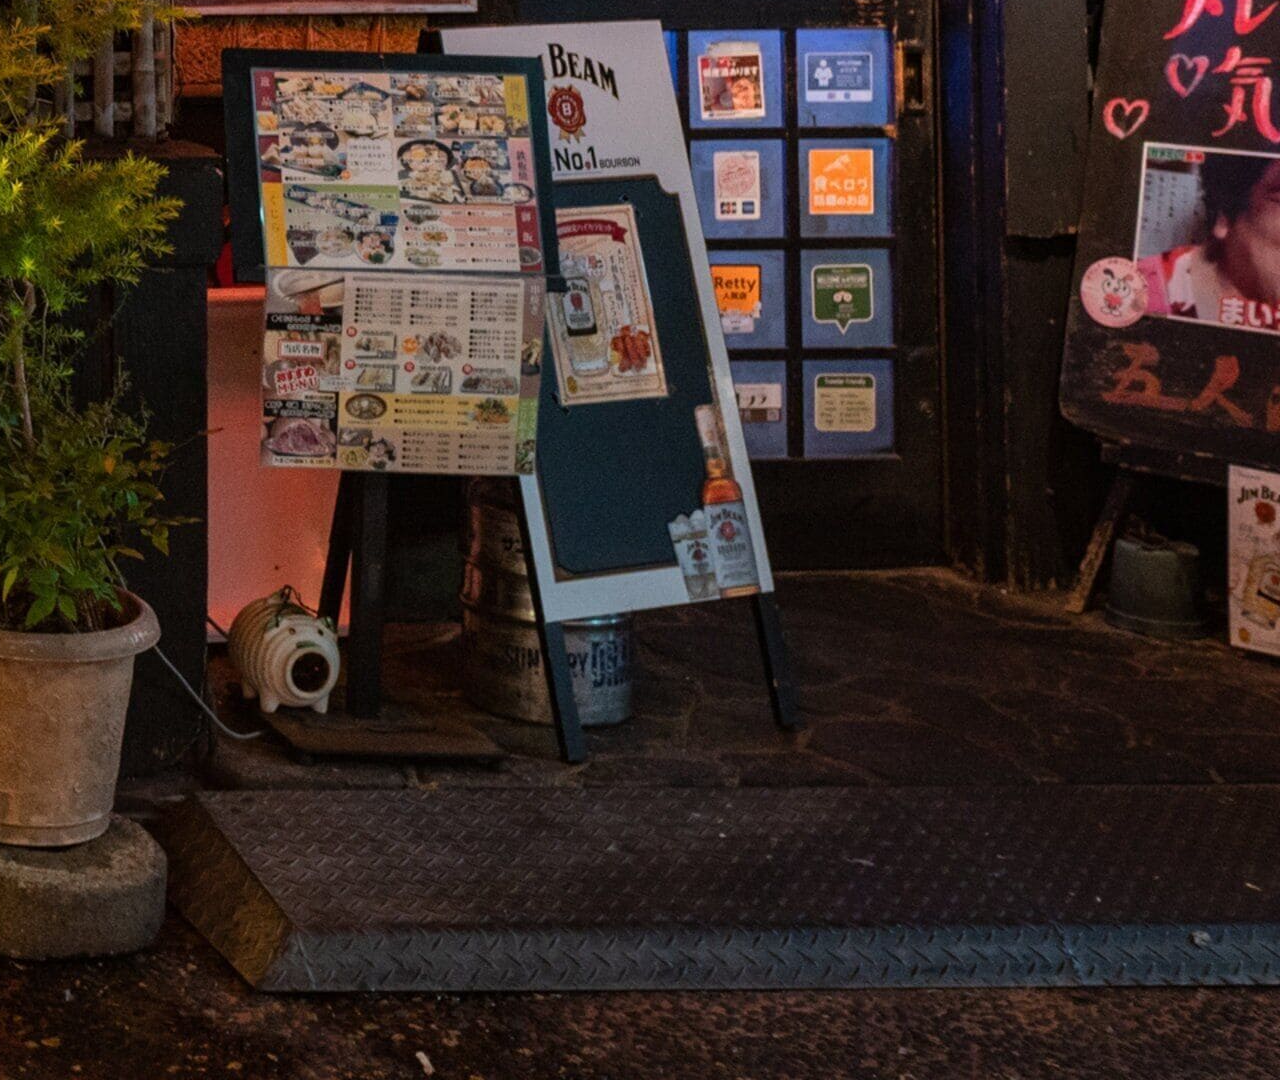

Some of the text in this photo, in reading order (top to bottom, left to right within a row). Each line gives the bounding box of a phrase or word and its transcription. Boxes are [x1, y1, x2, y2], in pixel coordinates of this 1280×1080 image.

[547, 42, 620, 101] BEAM
[599, 156, 641, 169] BOURBON
[714, 276, 757, 293] Retty
[1101, 342, 1280, 432] 五人
[1236, 485, 1258, 504] JIM
